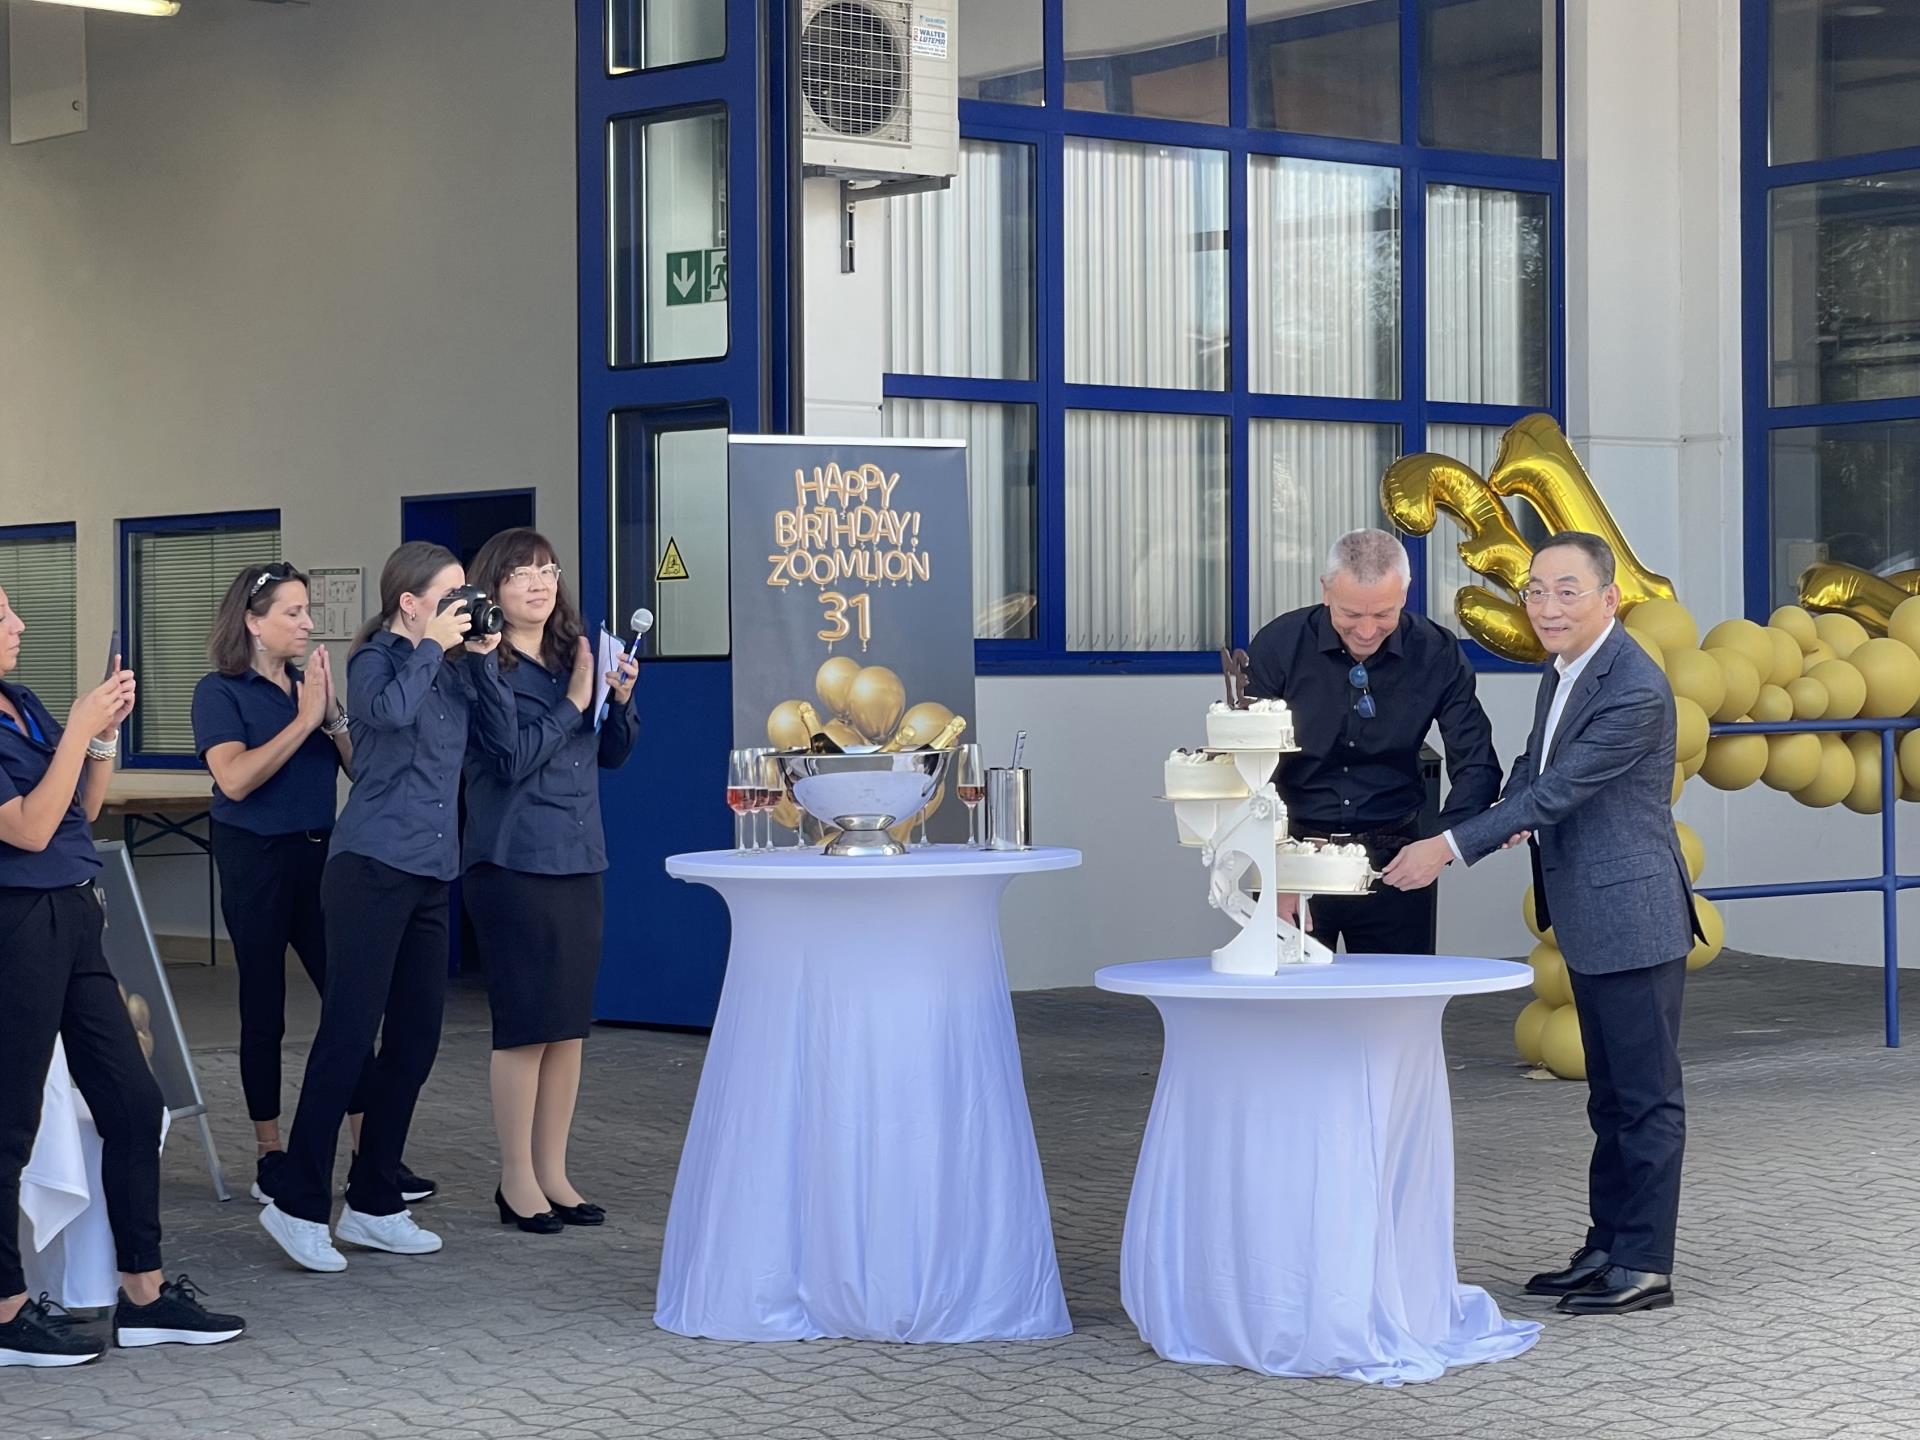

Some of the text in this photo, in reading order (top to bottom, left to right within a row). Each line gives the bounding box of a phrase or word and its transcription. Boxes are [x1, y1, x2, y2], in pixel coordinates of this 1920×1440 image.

[919, 29, 946, 38] WALTER
[795, 462, 900, 509] HAPPY
[775, 505, 920, 550] BIRTHDAY!
[767, 548, 930, 586] ZOOMLION
[817, 591, 871, 641] 31
